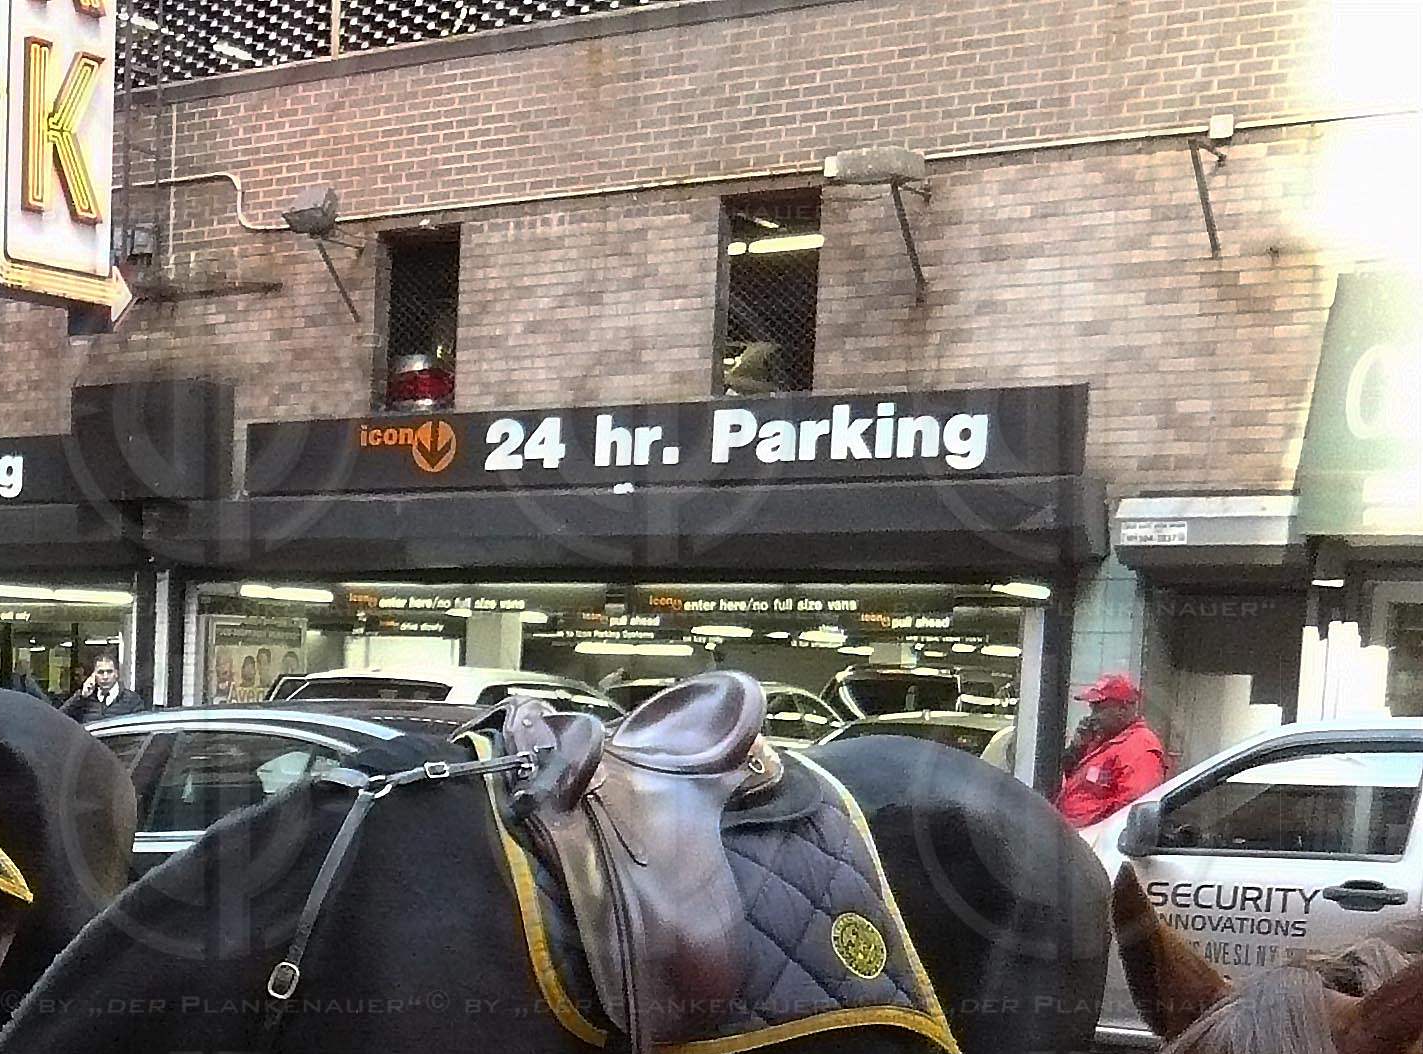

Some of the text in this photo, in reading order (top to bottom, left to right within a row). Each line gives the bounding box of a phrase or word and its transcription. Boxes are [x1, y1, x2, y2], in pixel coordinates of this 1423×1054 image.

[360, 403, 989, 472] icon 24 hr. Parking
[683, 600, 717, 612] enter
[719, 597, 769, 612] here/no
[773, 598, 793, 611] full
[797, 598, 823, 611] size
[827, 600, 857, 612] vans
[1146, 881, 1322, 915] SECURITY
[1159, 912, 1308, 938] NNOVATIONS
